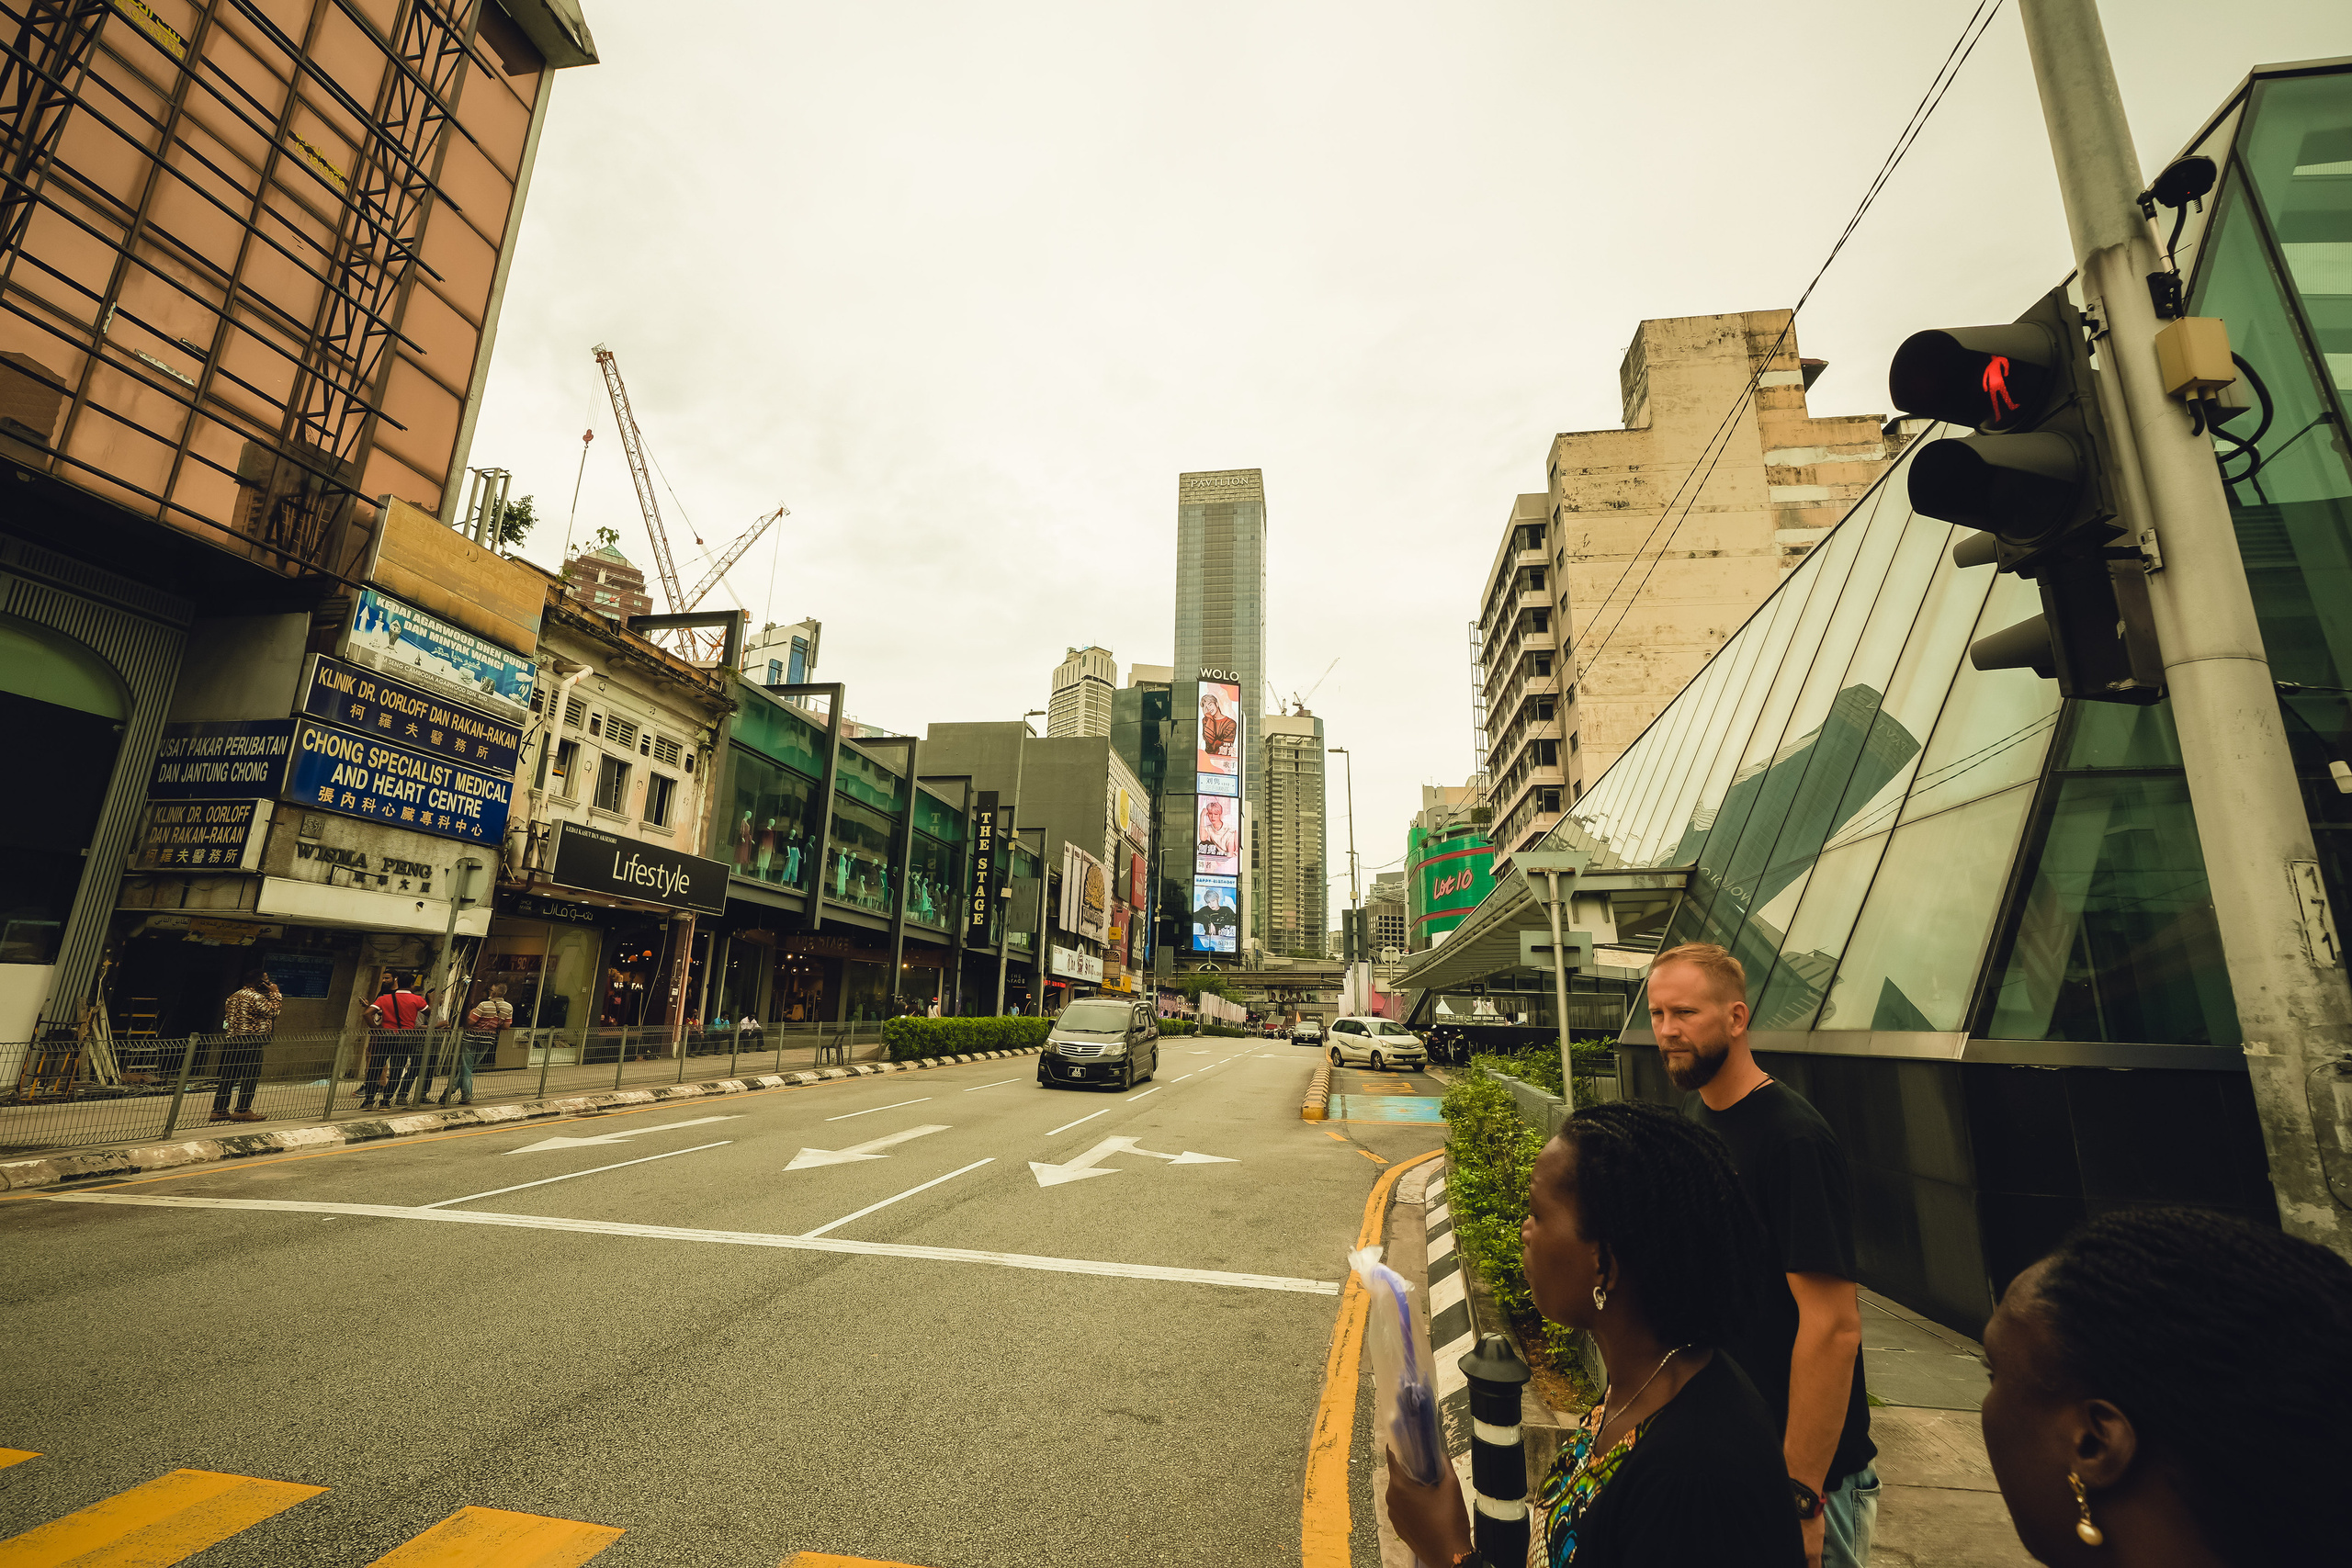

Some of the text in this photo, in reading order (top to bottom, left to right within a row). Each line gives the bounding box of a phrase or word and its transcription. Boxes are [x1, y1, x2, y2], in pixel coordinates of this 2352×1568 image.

[1190, 477, 1250, 488] PAVILION
[376, 597, 412, 619] KEDAI
[412, 612, 474, 647] AGARWOOD
[476, 638, 502, 658] DHEN
[503, 653, 529, 671] OUDH
[403, 620, 427, 638] DAN
[428, 631, 470, 656] MINYAK
[471, 650, 504, 671] WANGI
[404, 663, 435, 682] CAMBODIA
[435, 677, 466, 694] AGARWOOD
[1200, 667, 1239, 681] WOLO
[318, 667, 356, 695] KLINIK
[357, 681, 377, 703] DR.
[379, 689, 429, 719] OORLOFF
[429, 705, 449, 727] DAN
[451, 714, 518, 750] RAKAN-RAKAN
[187, 737, 224, 756] PAKAR
[223, 736, 288, 756] PERUBATAN
[158, 761, 268, 783] DAN JANTUNG CHONG
[302, 728, 508, 804] CHONG SPECIALIST MEDICAL
[331, 763, 483, 818] AND HEART CENTRE
[153, 805, 252, 823] KLINIK DR. OORLOFF
[149, 827, 245, 844] DAN RAKAN-RAKAN
[295, 841, 433, 879] WISMA PENG
[612, 851, 690, 897] Lifestyle
[972, 812, 992, 925] THE STAGE
[1433, 868, 1474, 900] Lot 10
